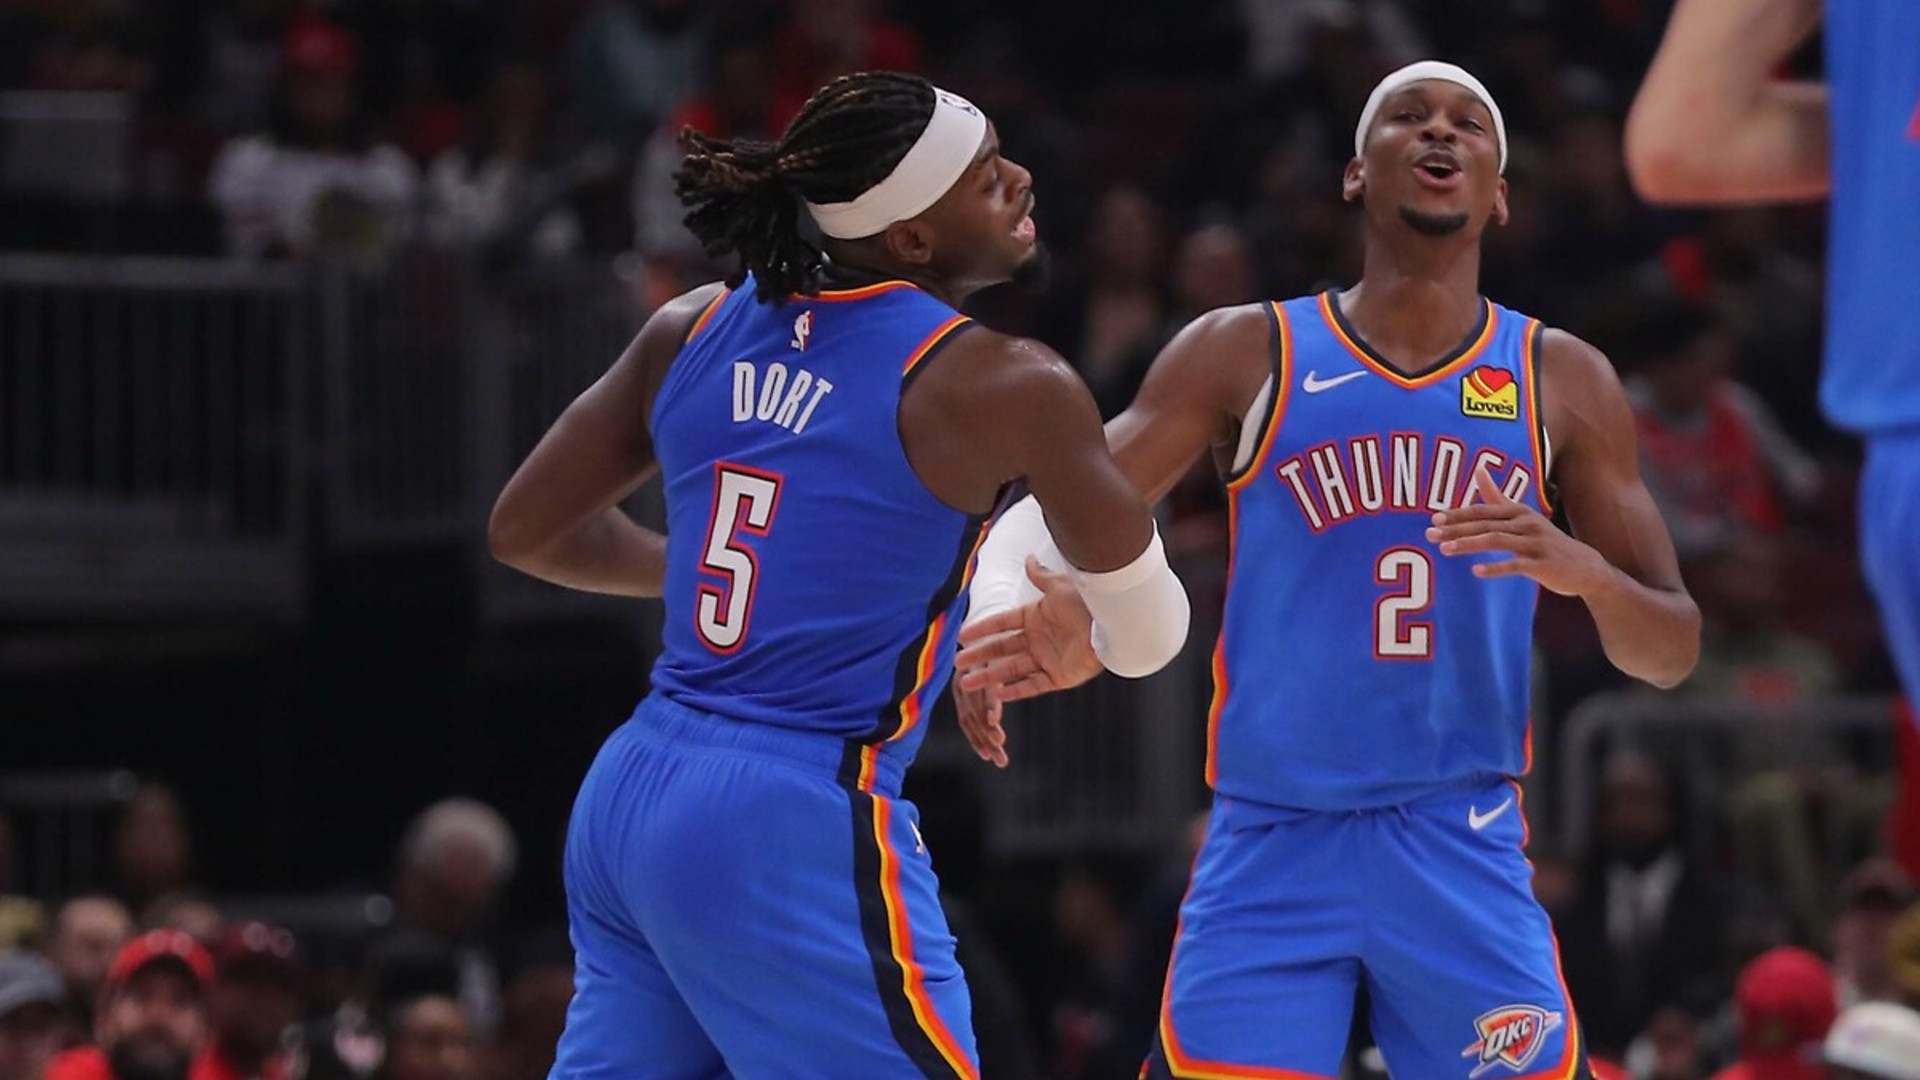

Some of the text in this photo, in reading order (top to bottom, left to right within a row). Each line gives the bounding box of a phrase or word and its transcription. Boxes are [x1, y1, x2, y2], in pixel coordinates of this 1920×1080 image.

[732, 361, 833, 435] DORT
[1465, 397, 1514, 415] Love's
[695, 461, 784, 655] 5
[1374, 546, 1433, 659] 2
[1482, 1016, 1531, 1062] OKC
